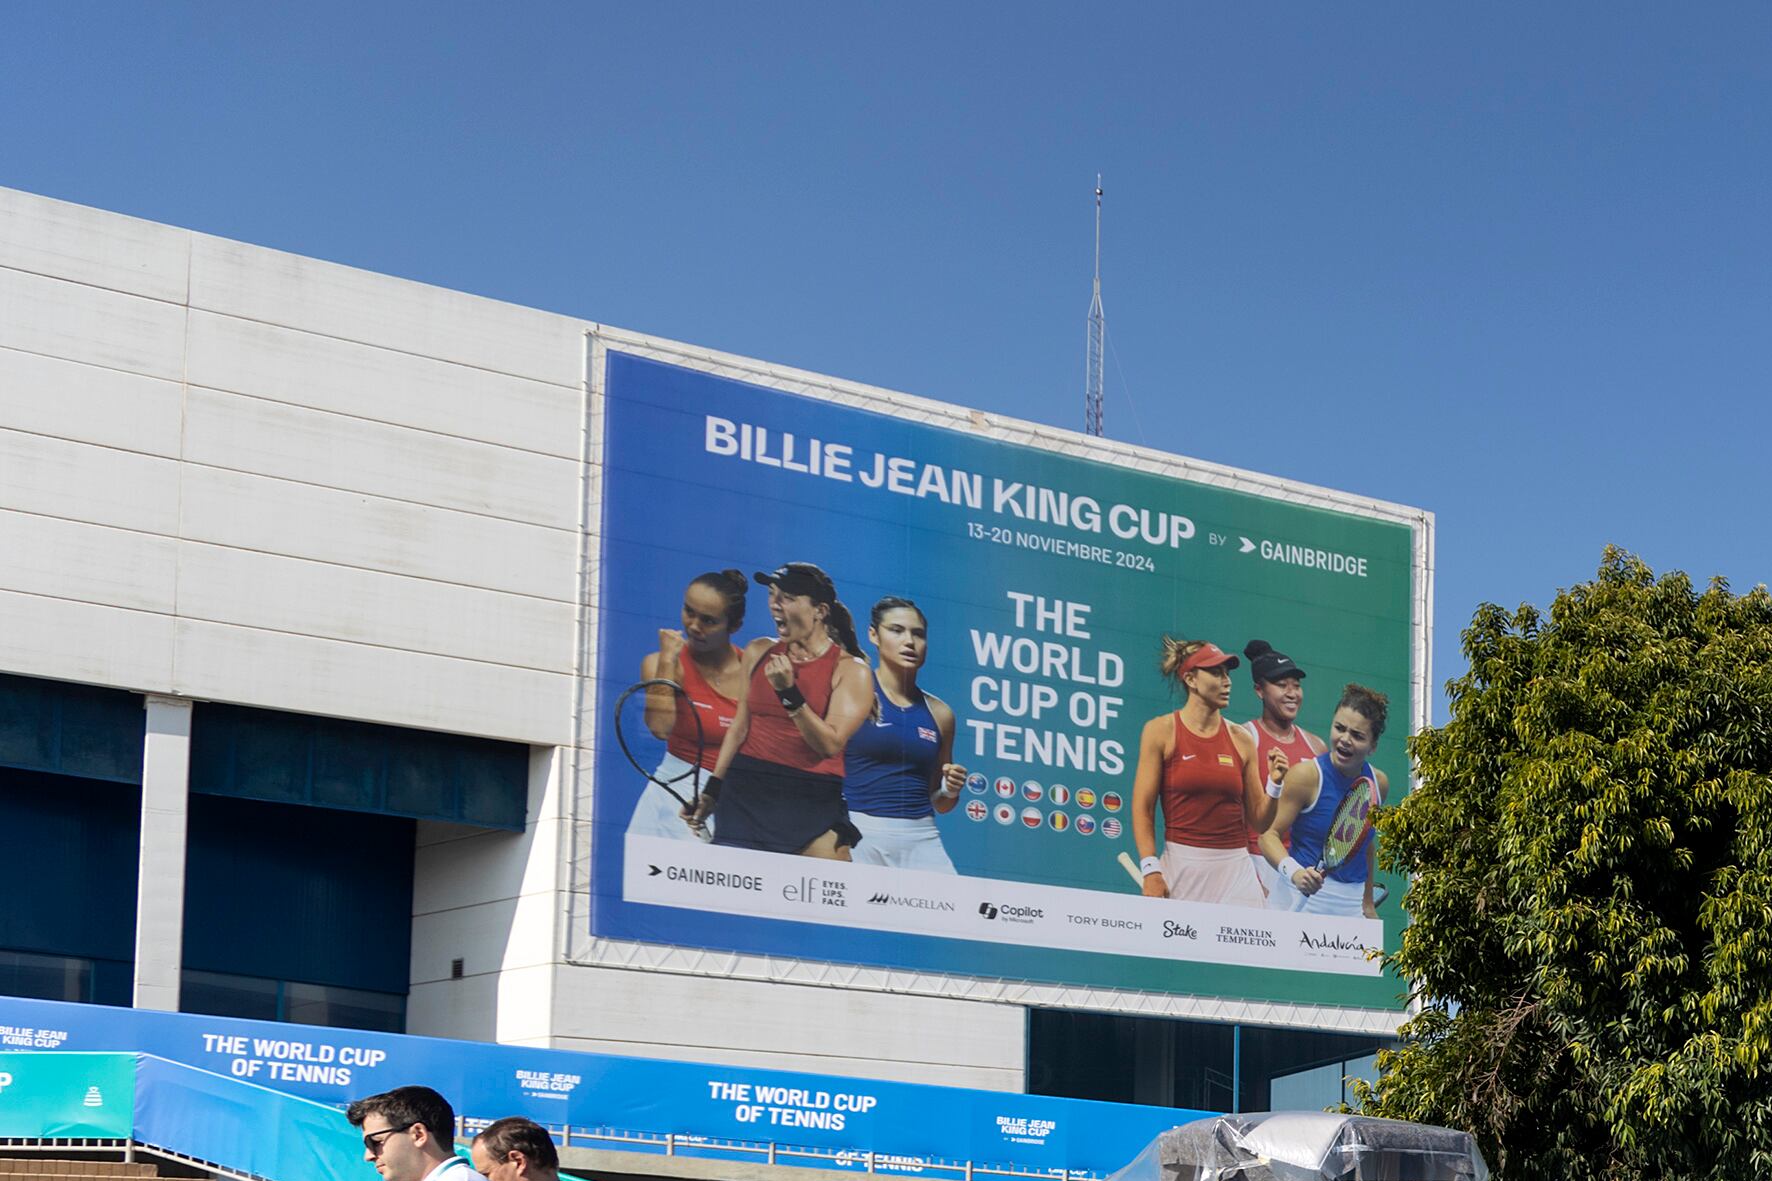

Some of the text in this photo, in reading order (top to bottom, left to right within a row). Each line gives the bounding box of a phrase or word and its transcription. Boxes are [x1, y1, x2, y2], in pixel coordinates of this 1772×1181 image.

[705, 414, 1196, 549] BILLIE JEAN KING CUP
[967, 521, 1155, 573] 13-20 NOVIEMBRE 2024
[1209, 532, 1368, 577] BY GAINBRIDGE
[1007, 591, 1092, 640] THE
[970, 629, 1125, 688] WORLD
[971, 675, 1124, 730] CUP OF
[966, 719, 1125, 776] TENNIS
[666, 866, 763, 892] GAINBRIDGE
[782, 876, 819, 903] elf
[889, 895, 955, 912] MAGELLAN
[1000, 904, 1043, 919] Copilot
[1066, 914, 1142, 931] TORY BURCH
[1163, 920, 1198, 940] Stake
[1220, 926, 1272, 939] FRANKLIN
[1215, 934, 1276, 948] TEMPLETON
[2, 1035, 61, 1049] KING CUP
[34, 1029, 68, 1040] JEAN
[202, 1033, 386, 1068] THE WORLD CUP
[231, 1058, 352, 1086] OF TENNIS
[516, 1069, 581, 1085] BILLIE JEAN
[521, 1079, 575, 1092] KING CUP
[708, 1080, 877, 1113] THE WORLD CUP
[735, 1105, 846, 1131] OF TENNIS
[996, 1116, 1056, 1130] BILLIE JEAN
[1001, 1125, 1050, 1137] KING CUP
